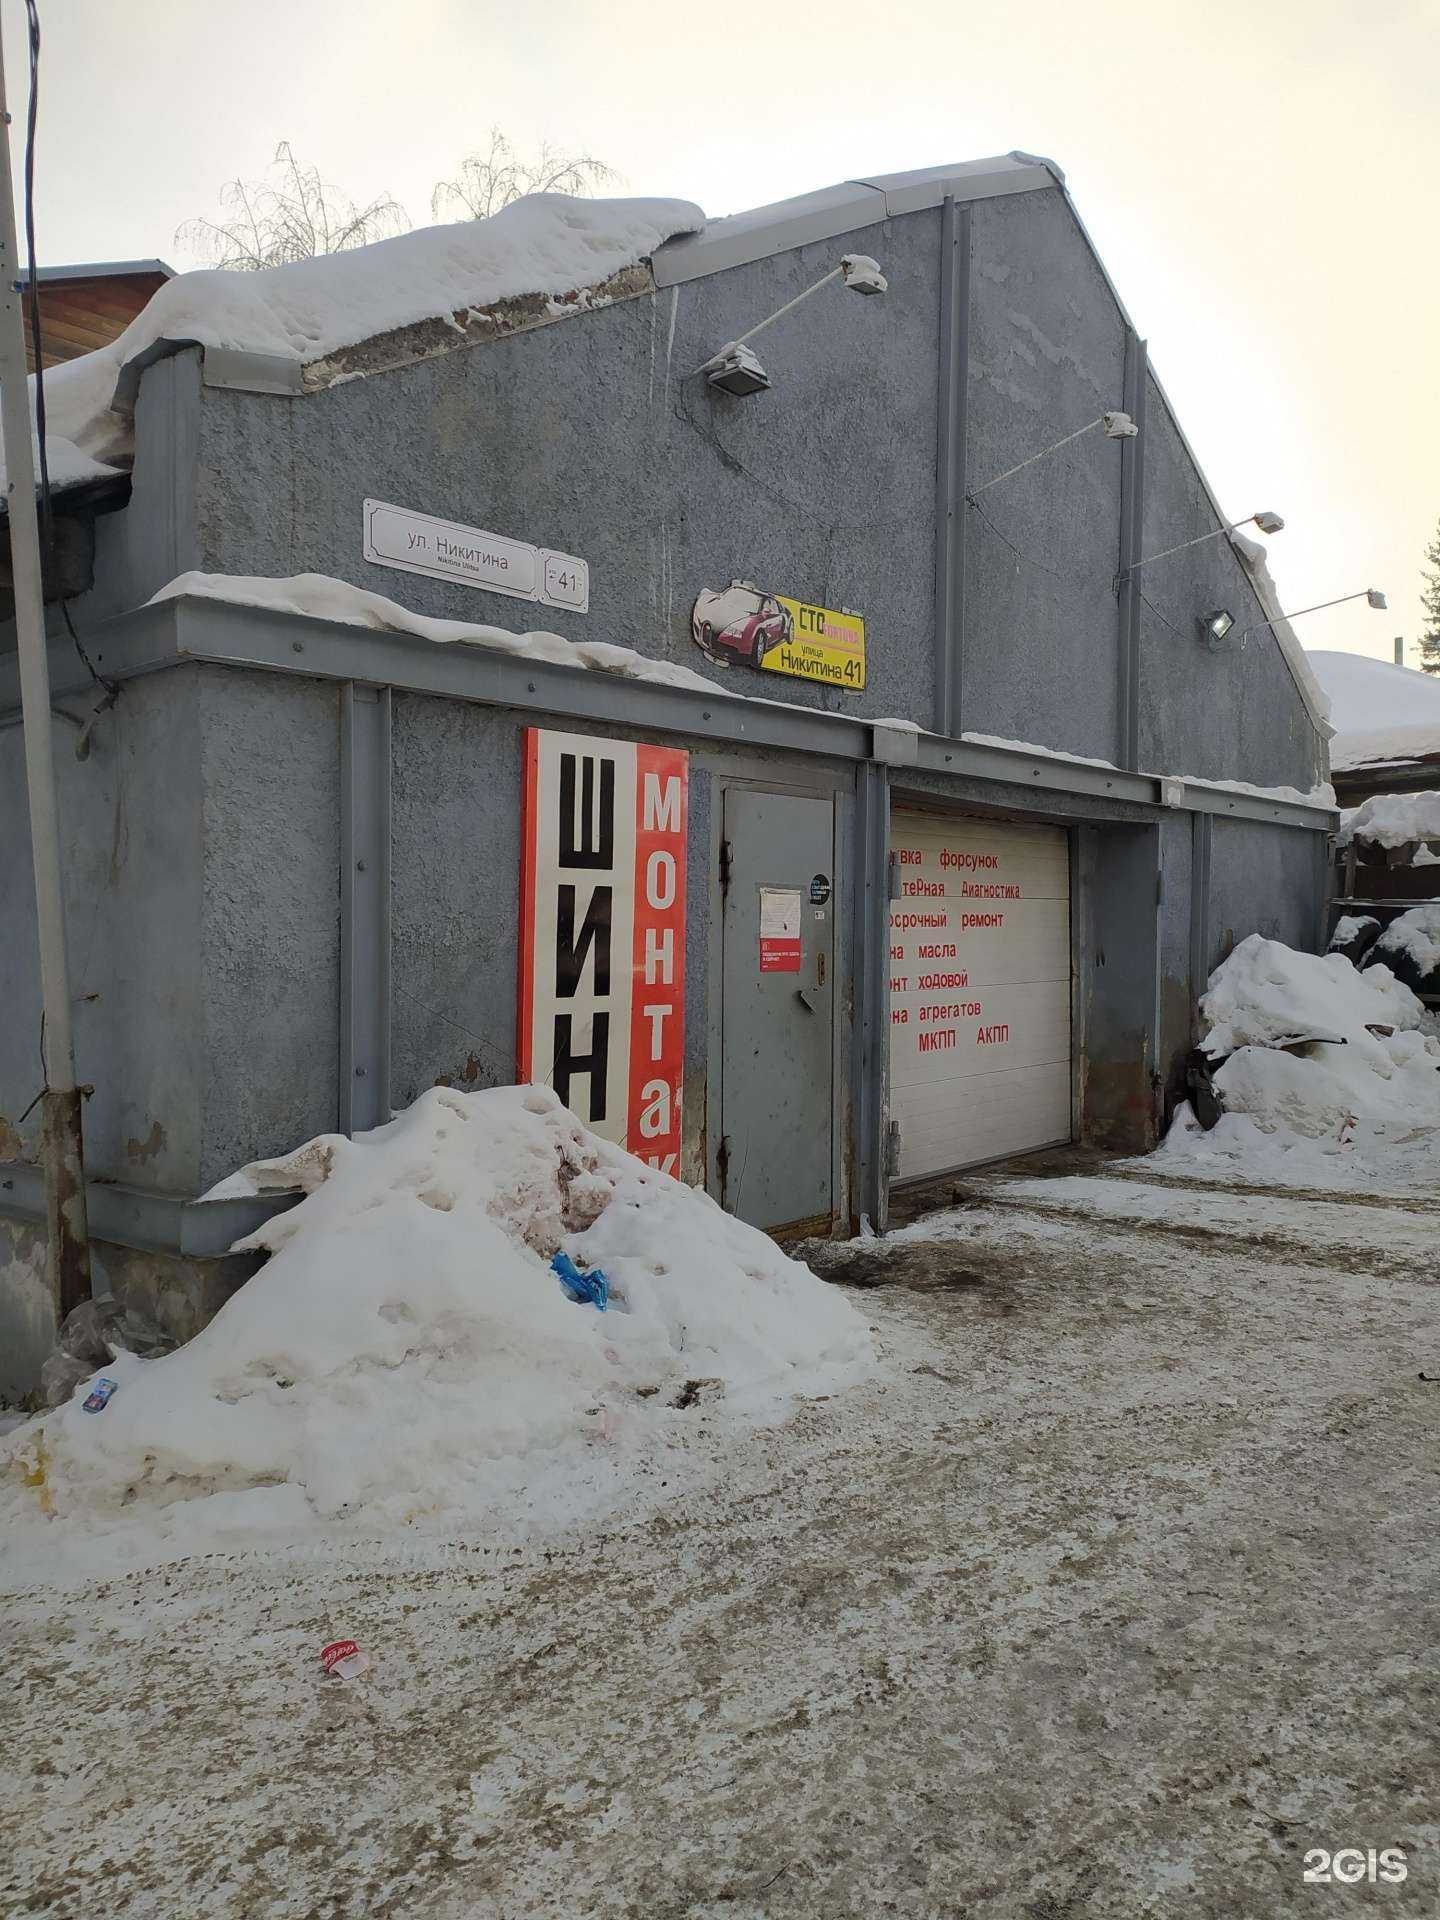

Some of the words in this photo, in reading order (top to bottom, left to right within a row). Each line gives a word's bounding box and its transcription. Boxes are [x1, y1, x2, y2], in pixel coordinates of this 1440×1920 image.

[408, 533, 430, 549] ул.
[436, 536, 508, 570] Никитина
[558, 571, 576, 592] 41
[800, 607, 825, 635] СТО
[801, 644, 824, 658] улица
[781, 647, 842, 679] Никитина
[844, 659, 861, 683] 41
[889, 849, 922, 865] вка
[940, 848, 999, 872] форсунок
[961, 913, 1004, 931] ремонт
[918, 944, 957, 959] масла
[639, 772, 681, 1174] МОНТа
[918, 968, 968, 990] ходовой
[890, 1009, 908, 1024] на
[919, 1002, 982, 1023] агрегатов
[918, 1029, 956, 1052] МКПП
[976, 1025, 1009, 1045] АКПП
